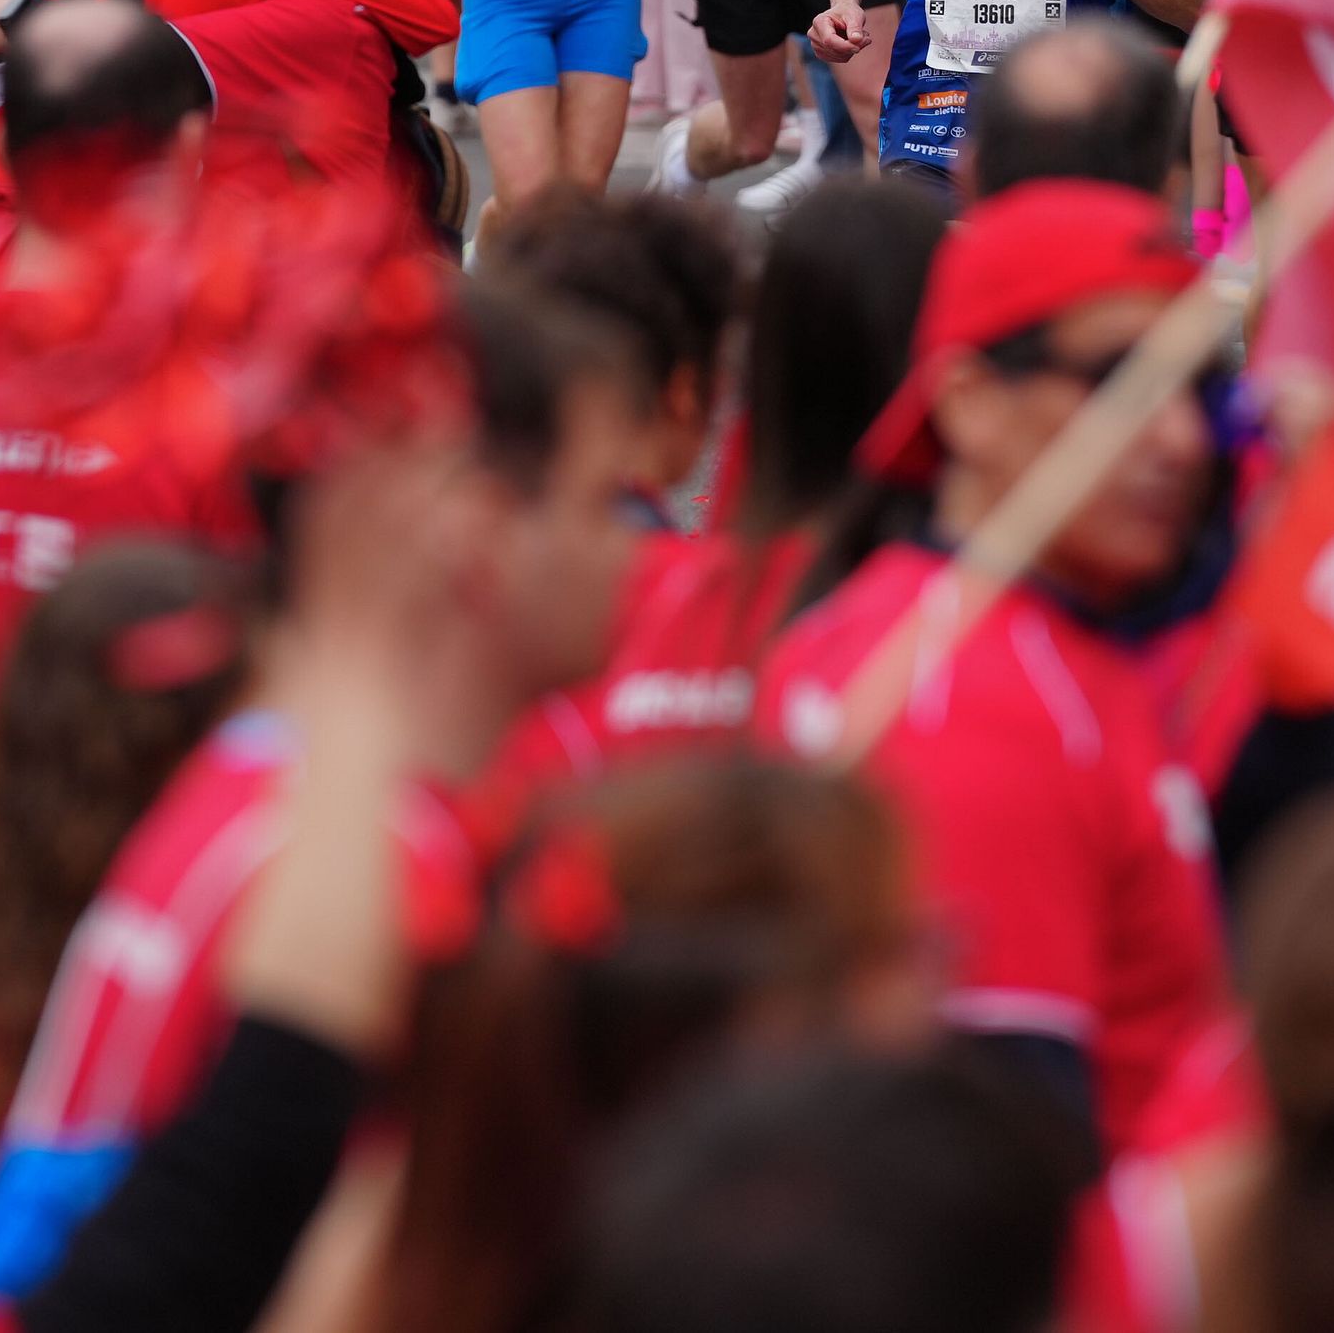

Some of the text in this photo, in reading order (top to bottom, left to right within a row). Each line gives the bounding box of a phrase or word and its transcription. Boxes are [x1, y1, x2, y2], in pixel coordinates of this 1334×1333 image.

[973, 4, 1015, 24] 13610
[927, 94, 965, 106] Lovato
[934, 105, 966, 116] electric
[912, 144, 938, 156] UTP
